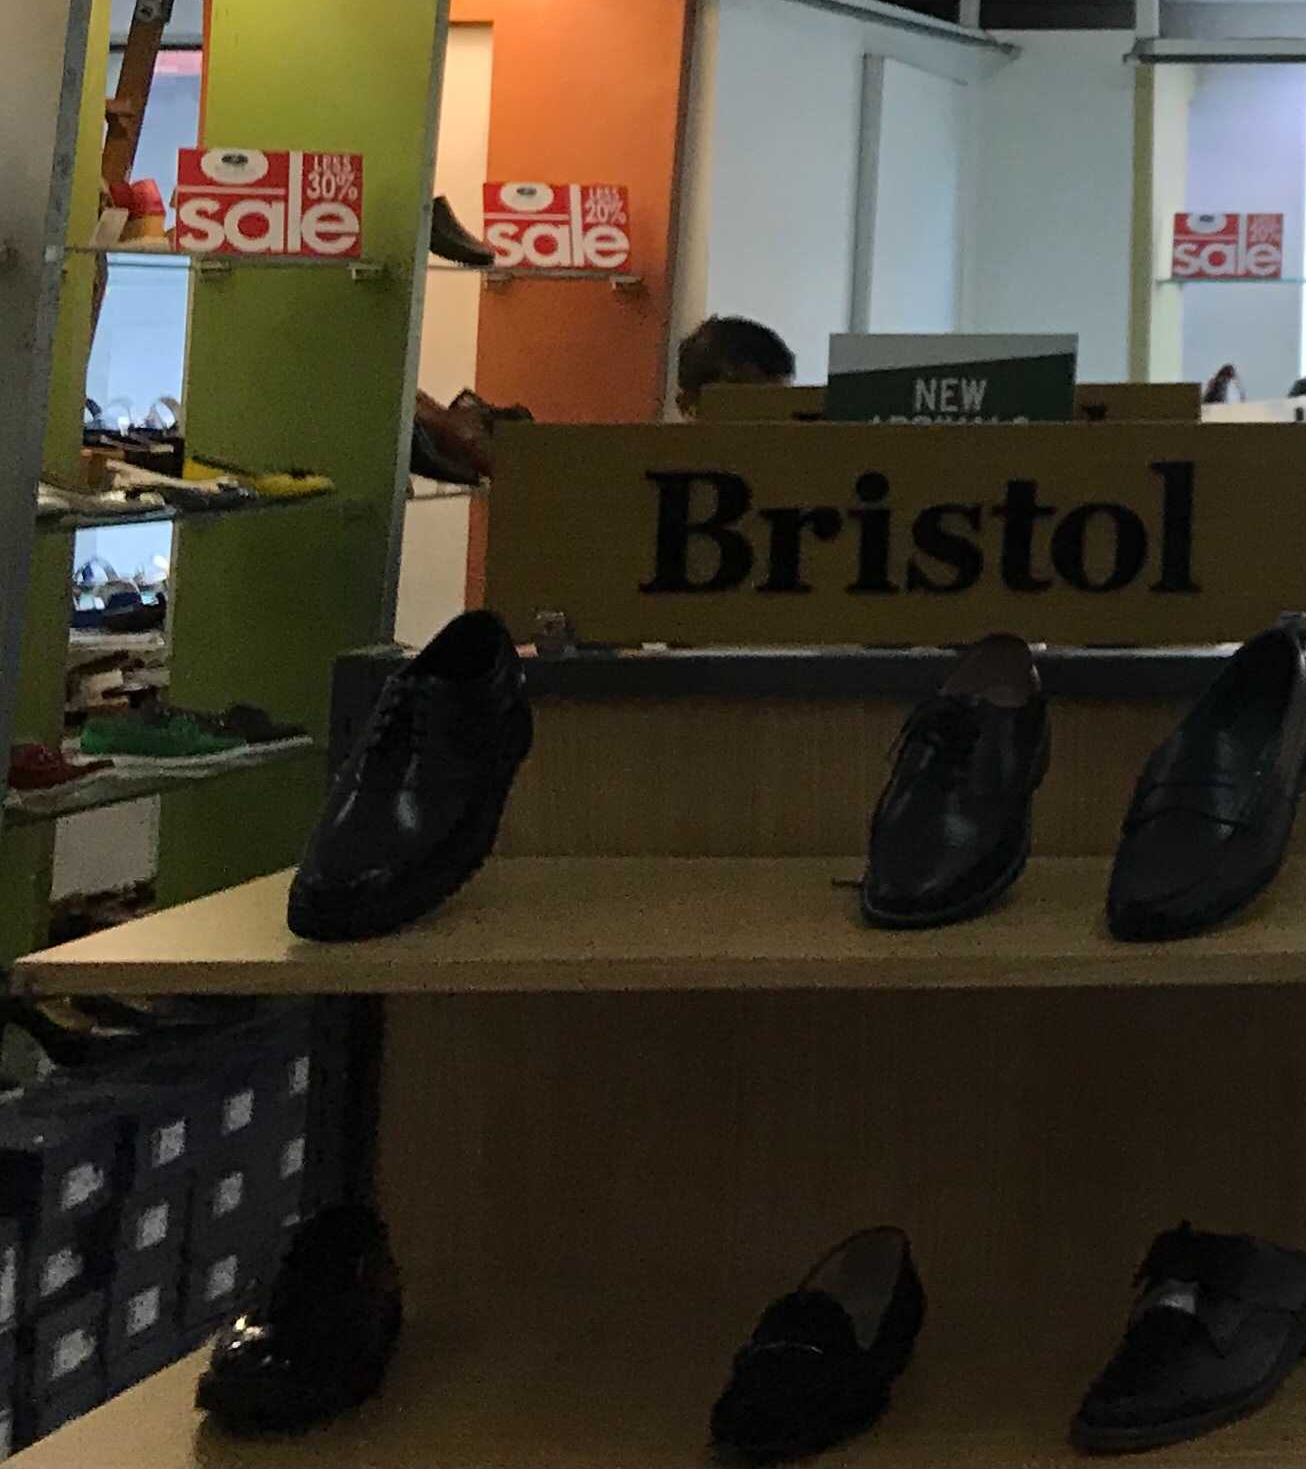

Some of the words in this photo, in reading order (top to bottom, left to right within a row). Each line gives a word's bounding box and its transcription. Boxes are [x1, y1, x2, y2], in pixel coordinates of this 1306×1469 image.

[306, 172, 358, 201] 30%
[313, 155, 353, 174] LESS
[178, 150, 360, 255] sale
[487, 184, 630, 268] sale
[1173, 213, 1281, 276] sale
[914, 377, 988, 413] NEW
[639, 460, 1203, 595] Bristol
